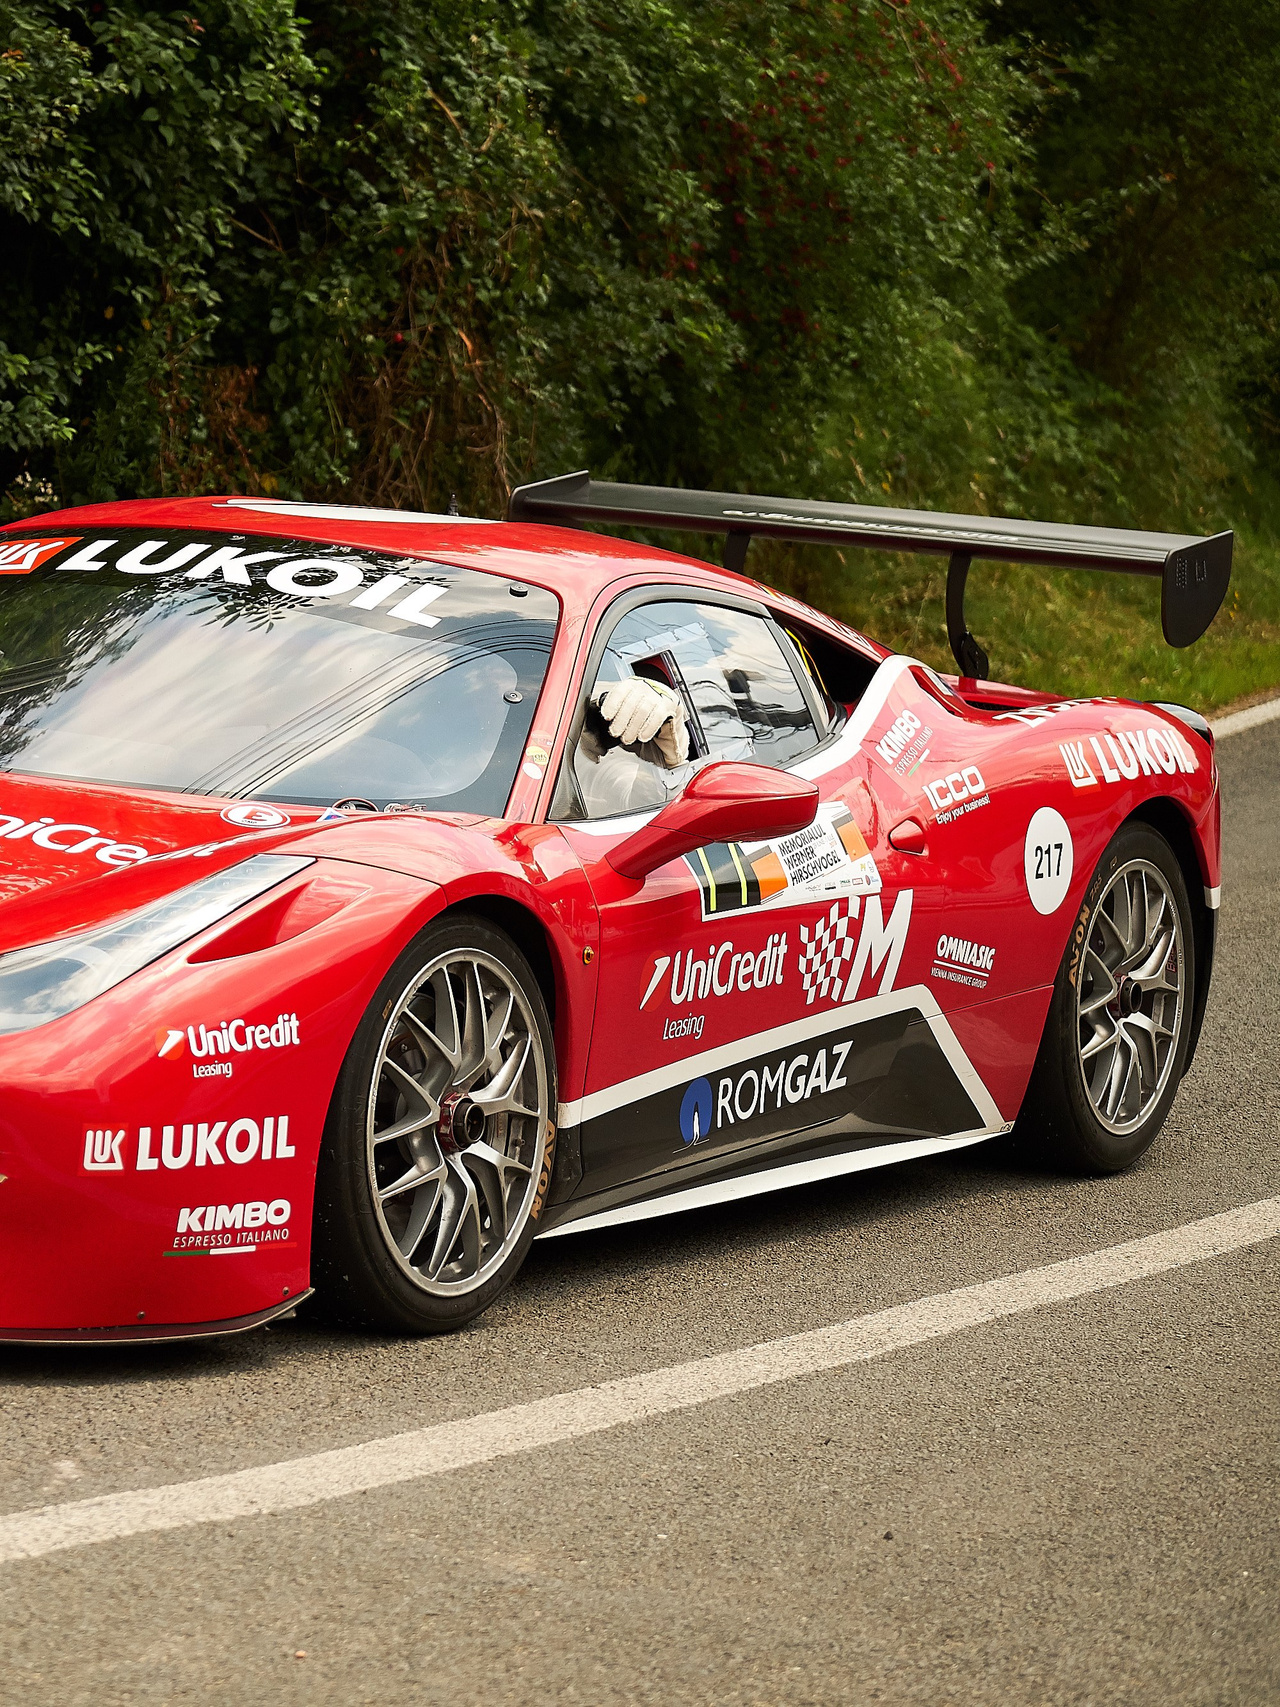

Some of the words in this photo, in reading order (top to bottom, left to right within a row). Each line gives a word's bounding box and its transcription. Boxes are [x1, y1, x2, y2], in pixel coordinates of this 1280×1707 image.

[55, 540, 450, 629] LUKOIL
[875, 709, 922, 765] KIMBO
[893, 746, 919, 776] ESPRESSO
[913, 726, 934, 752] ITALIANO
[1088, 727, 1195, 784] LUKOIL
[921, 765, 986, 811] ICCO
[935, 811, 952, 825] Enjoy
[951, 805, 965, 821] your
[963, 793, 991, 813] business!
[777, 823, 827, 858] MEMORIALUL
[784, 845, 818, 871] WERNER
[1035, 843, 1063, 879] 217
[789, 850, 842, 887] HIRSCHVOGEL
[937, 934, 996, 971] OMNIASIG
[1068, 904, 1091, 989] AVON
[671, 932, 788, 1005] UniCredit
[930, 967, 948, 980] VIENNA
[947, 971, 973, 986] INSURANCE
[971, 978, 988, 989] GROUP
[187, 1012, 300, 1058] UniCredit
[663, 1012, 705, 1041] Leasing
[192, 1060, 233, 1079] Leasing
[717, 1040, 854, 1129] ROMGAZ
[136, 1115, 296, 1171] LUKOIL
[531, 1118, 556, 1221] AVON
[176, 1199, 291, 1233] KIMBO
[173, 1233, 232, 1248] ESPRESSO
[236, 1228, 290, 1244] ITALIANO
